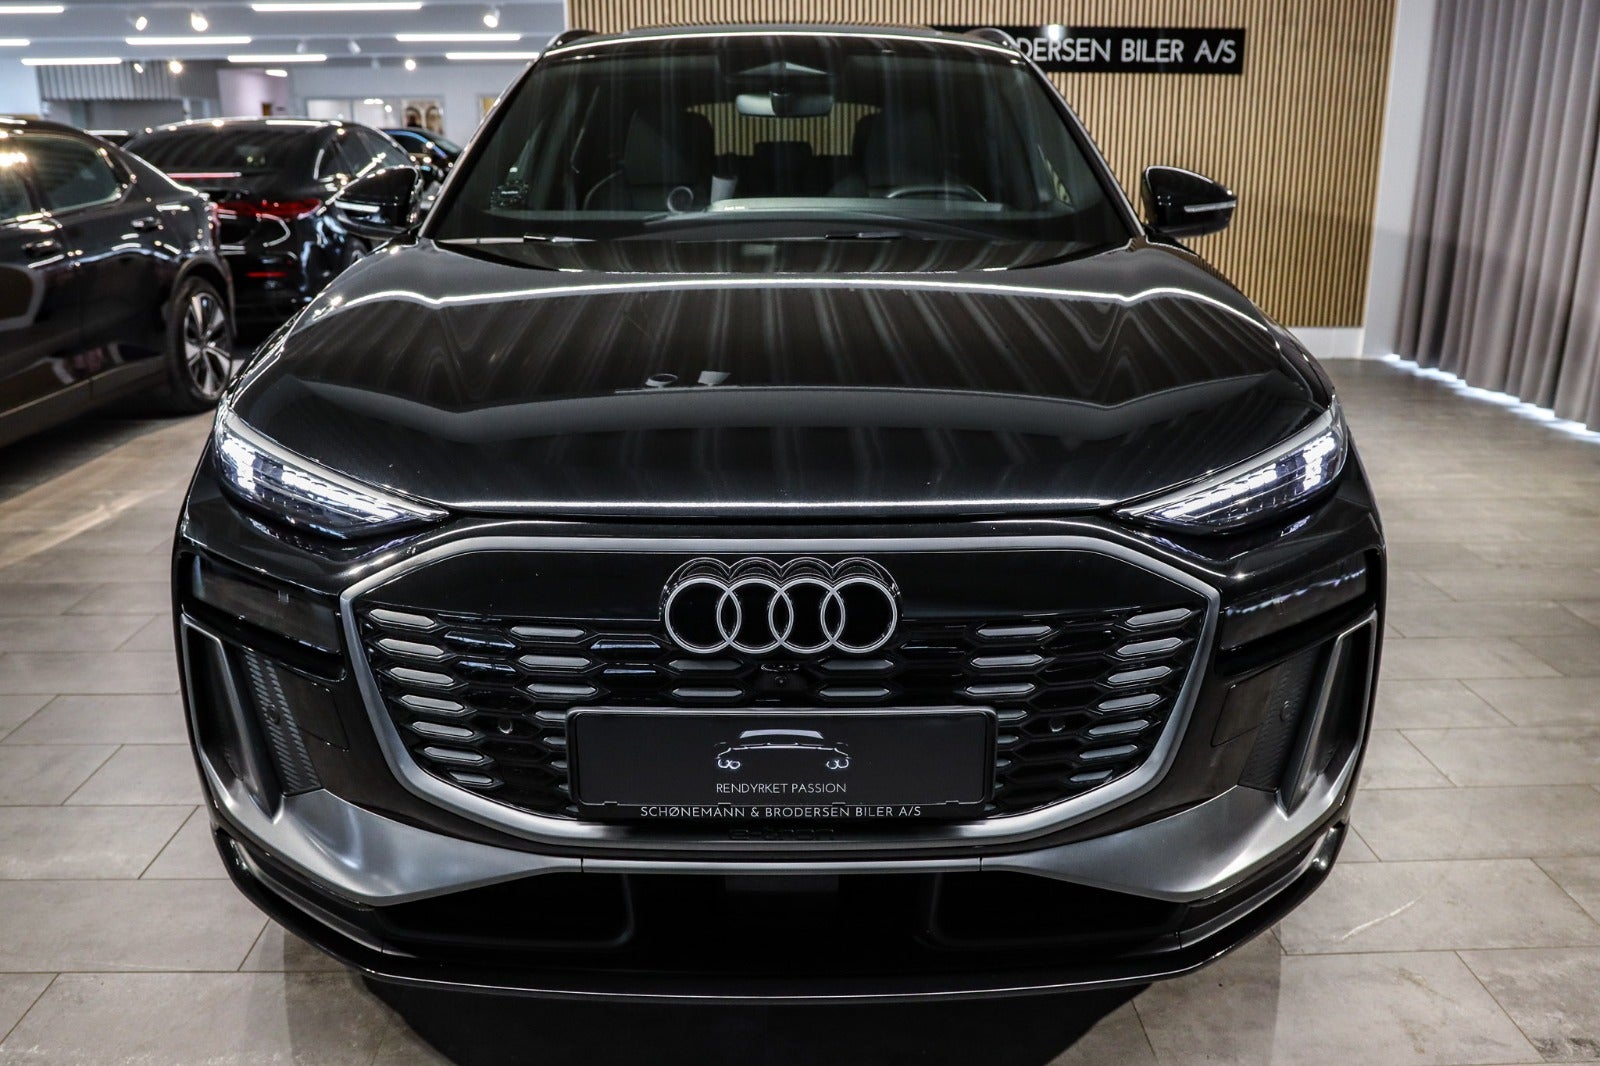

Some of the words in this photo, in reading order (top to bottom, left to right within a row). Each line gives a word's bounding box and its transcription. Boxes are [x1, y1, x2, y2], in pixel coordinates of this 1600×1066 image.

[1121, 38, 1184, 62] BILER
[1194, 38, 1236, 63] A/S
[716, 783, 788, 793] RENDYRKET
[791, 783, 847, 793] PASSION
[640, 806, 745, 817] SCHØNEMANN
[750, 806, 760, 817] &
[765, 807, 850, 817] BRODERSEN
[855, 806, 893, 817] BILER
[898, 806, 921, 816] A/S
